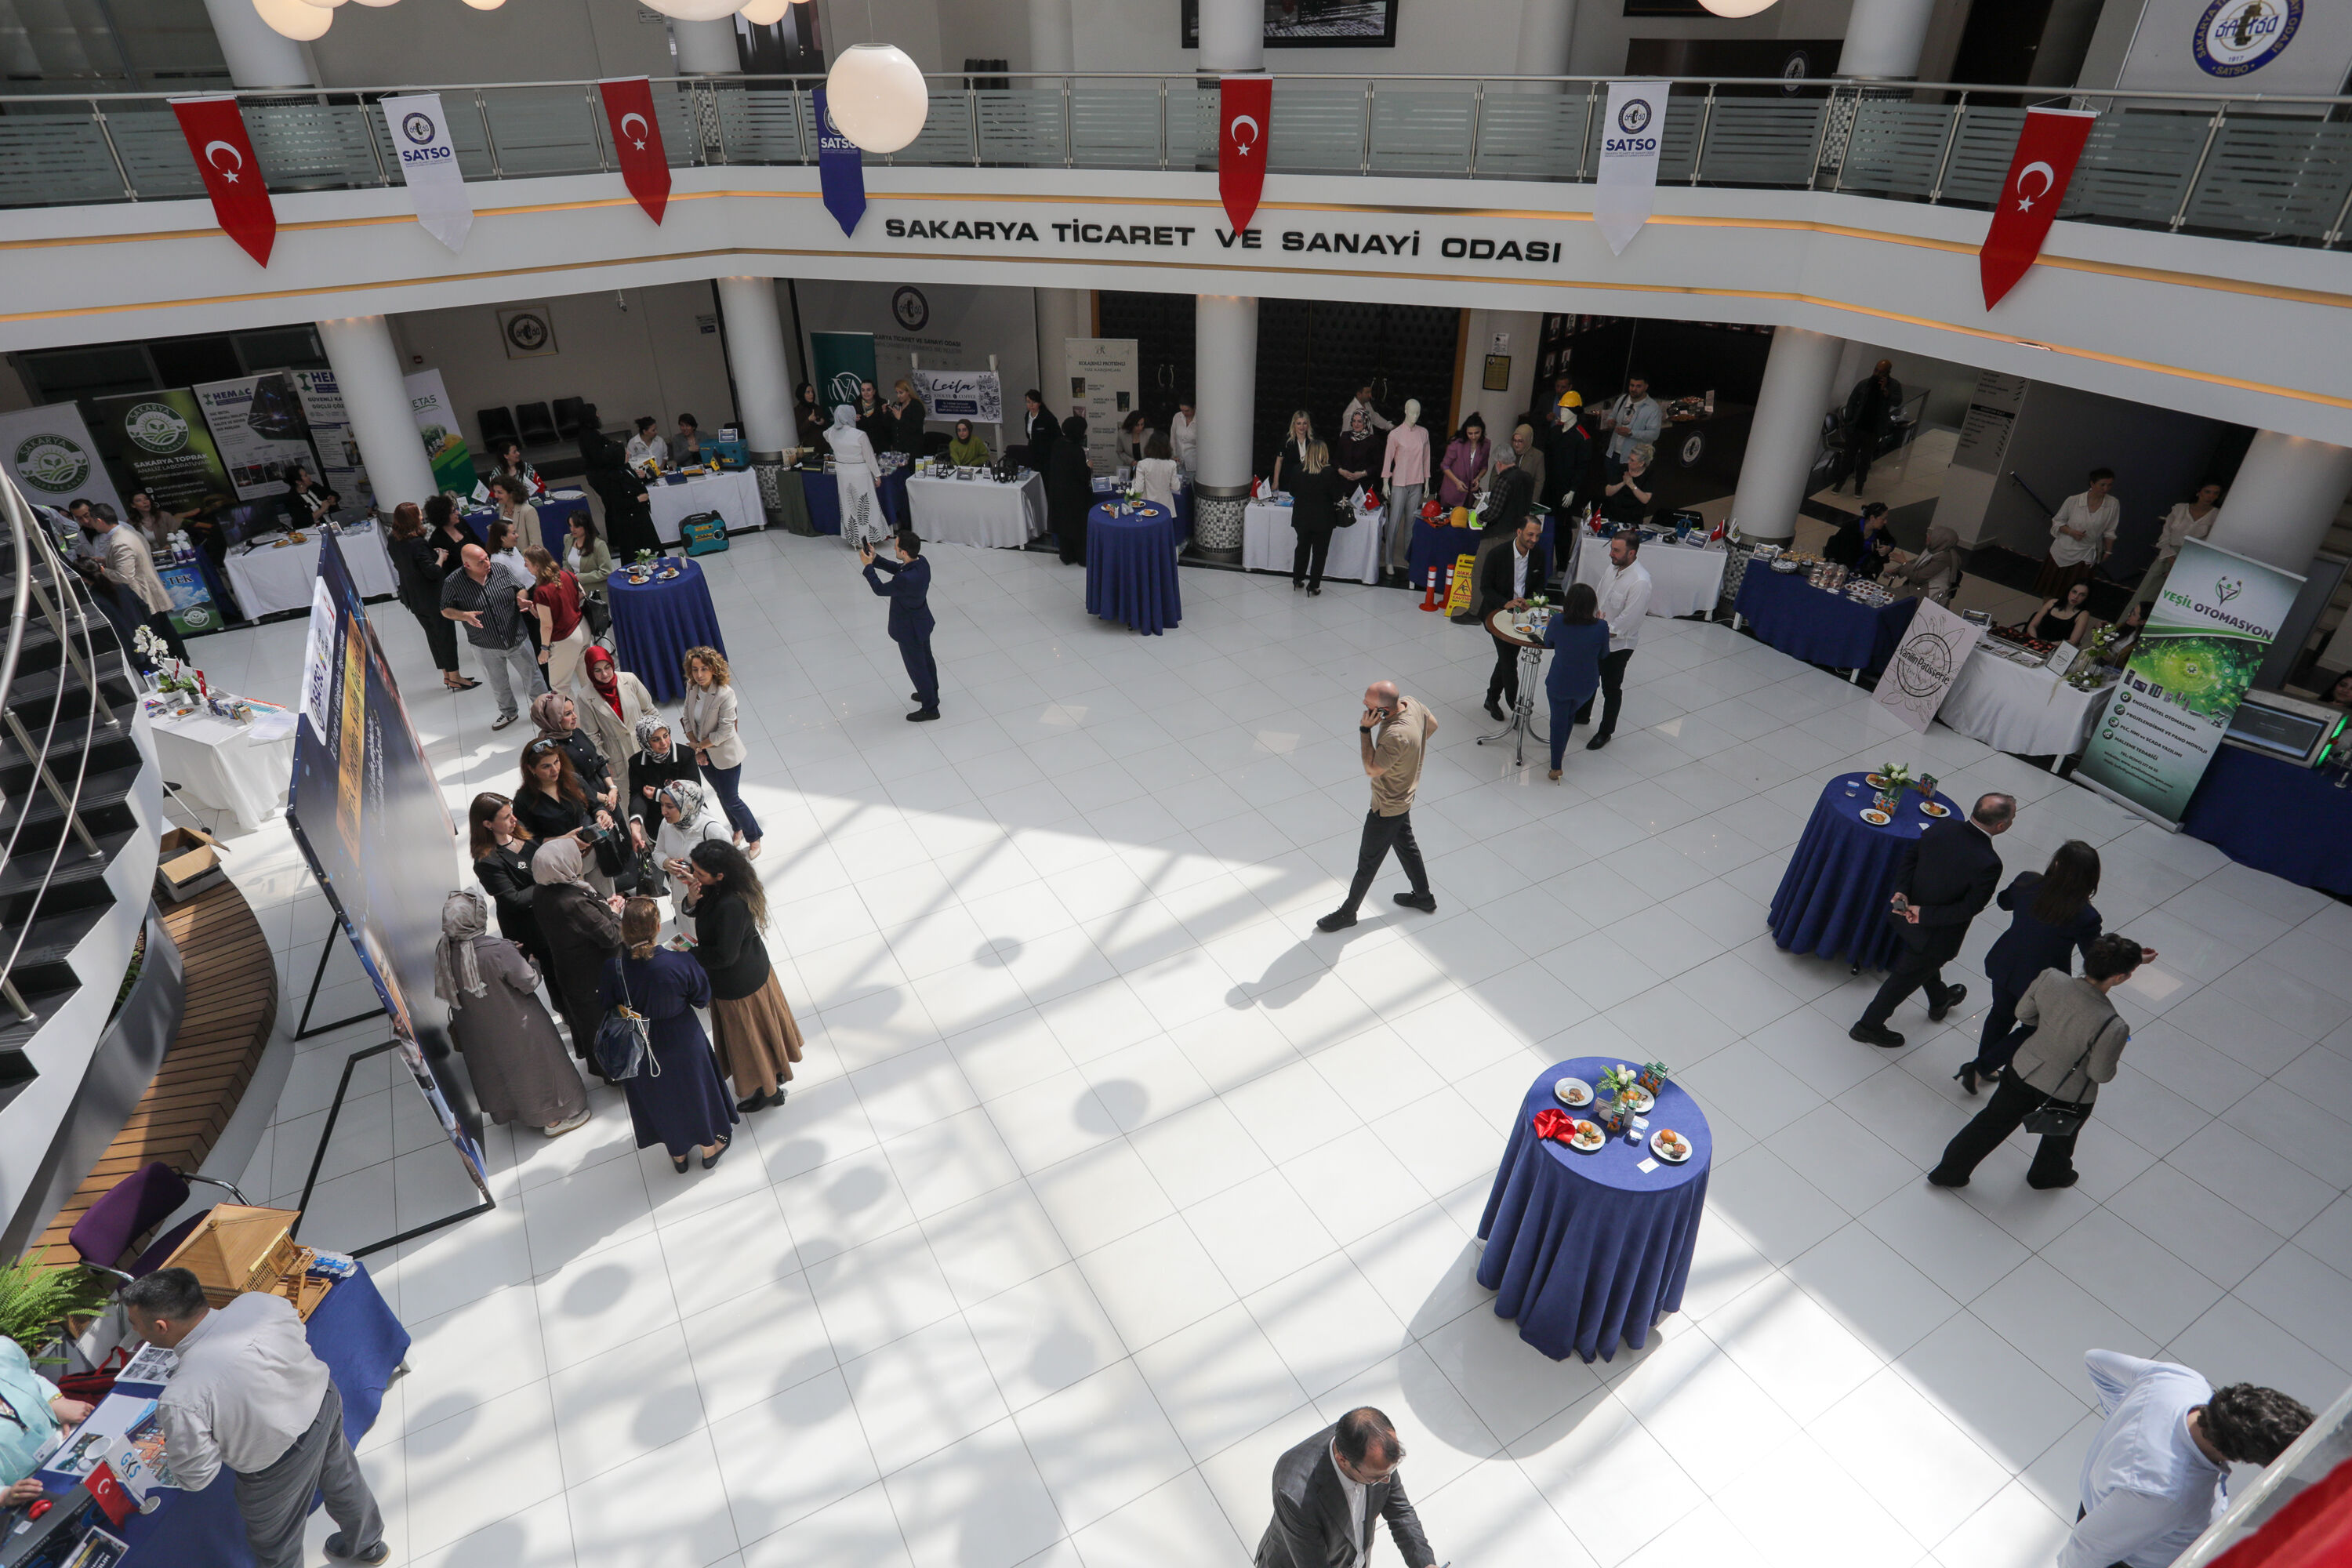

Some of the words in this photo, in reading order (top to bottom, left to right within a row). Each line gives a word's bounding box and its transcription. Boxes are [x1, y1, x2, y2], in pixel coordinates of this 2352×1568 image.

[2196, 9, 2216, 58] SAKARYA
[2272, 17, 2298, 53] ODASI
[2216, 64, 2249, 75] SATSO
[1606, 138, 1657, 151] SATSO
[403, 147, 451, 162] SATSO
[885, 219, 1039, 241] SAKARYA
[1052, 219, 1196, 246] TİCARET
[1214, 229, 1262, 249] VE
[1282, 230, 1420, 256] SANAYİ
[1441, 238, 1561, 263] ODASI
[932, 379, 975, 393] Leila
[129, 405, 169, 419] SAKARYA
[20, 437, 67, 456] SAKARYA
[133, 458, 173, 468] SAKARYA
[174, 453, 209, 463] TOPRAK
[167, 573, 194, 585] TEK
[2162, 589, 2192, 609] YEŞİL
[2194, 603, 2274, 641] OTOMASYON
[2132, 699, 2165, 717] ENDÜSTRİYEL
[2165, 713, 2196, 731] OTOMASYON
[2126, 712, 2165, 733] PROJELENDİRME
[2171, 733, 2186, 743] PANO
[2146, 737, 2161, 748] SCADA
[121, 1452, 141, 1479] GKS
